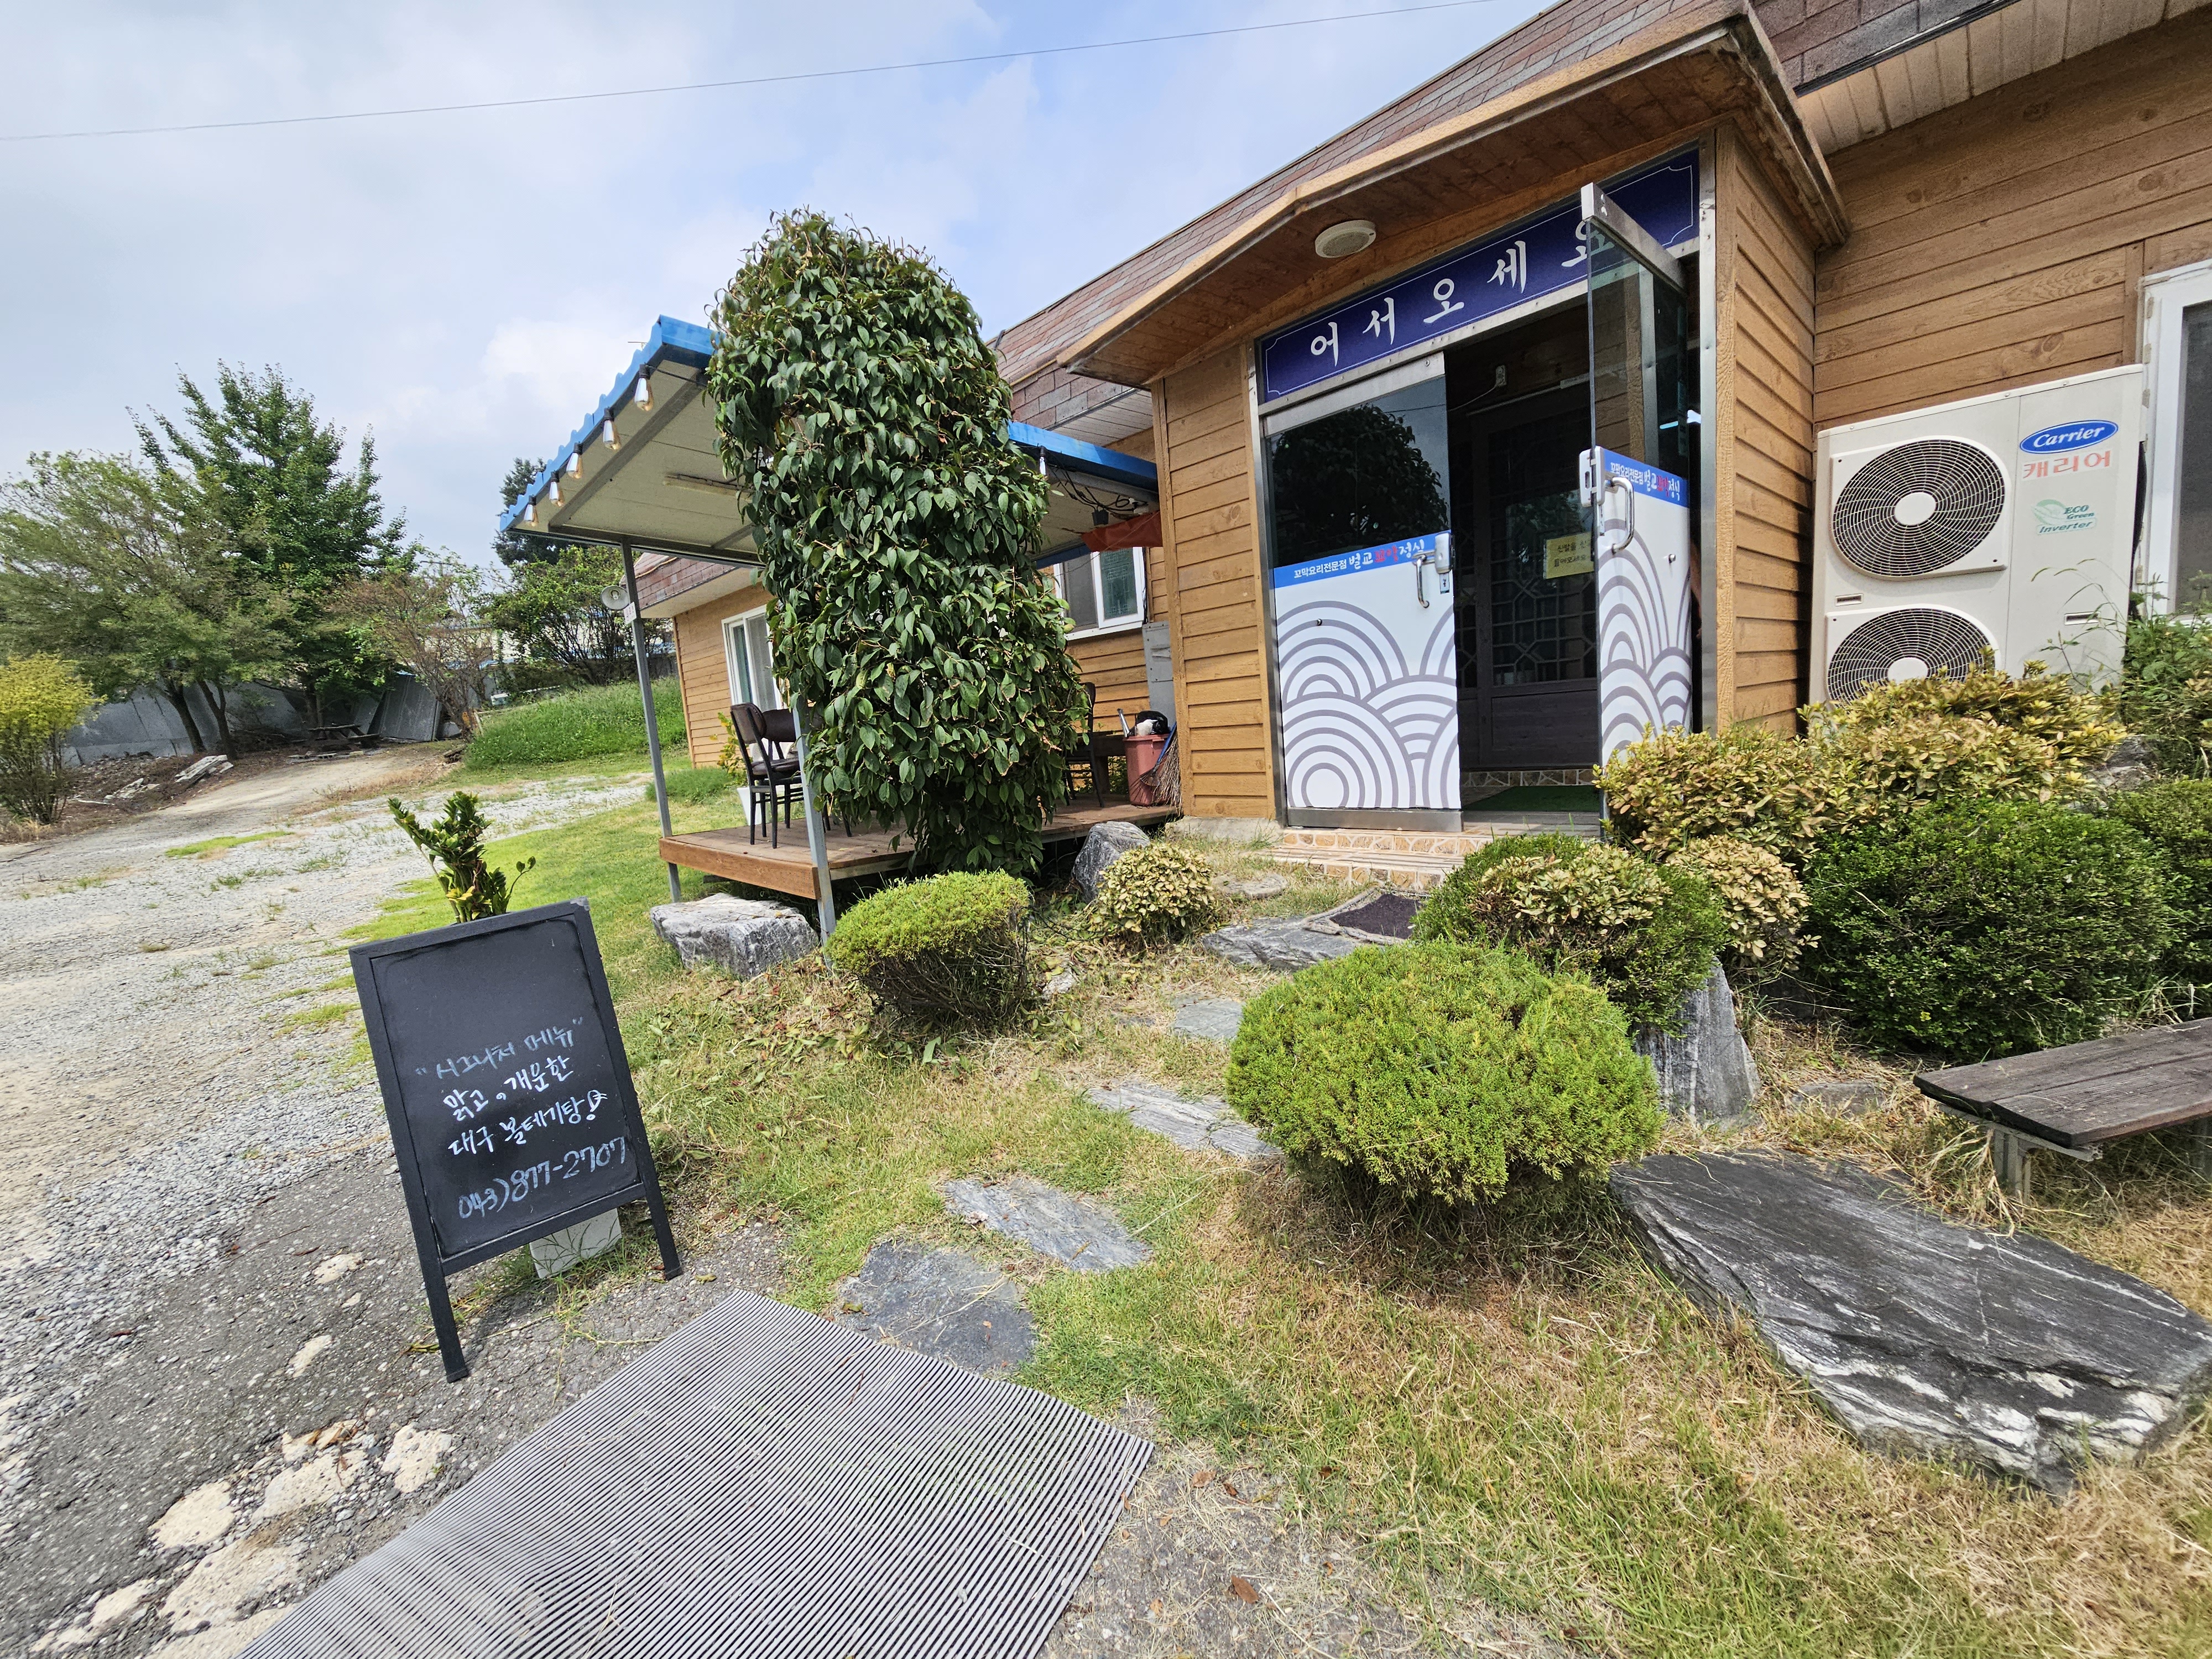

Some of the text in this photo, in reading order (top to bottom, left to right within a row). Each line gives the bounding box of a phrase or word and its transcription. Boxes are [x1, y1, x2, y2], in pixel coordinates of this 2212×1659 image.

[2033, 426, 2105, 447] Carrier
[2022, 450, 2111, 479] 캐리어
[2063, 504, 2089, 515] ECO
[2039, 521, 2093, 534] Inverter
[1293, 559, 1347, 578] 꼬막요리전문점
[503, 1055, 573, 1092] 개운한
[448, 1126, 494, 1155] 대구
